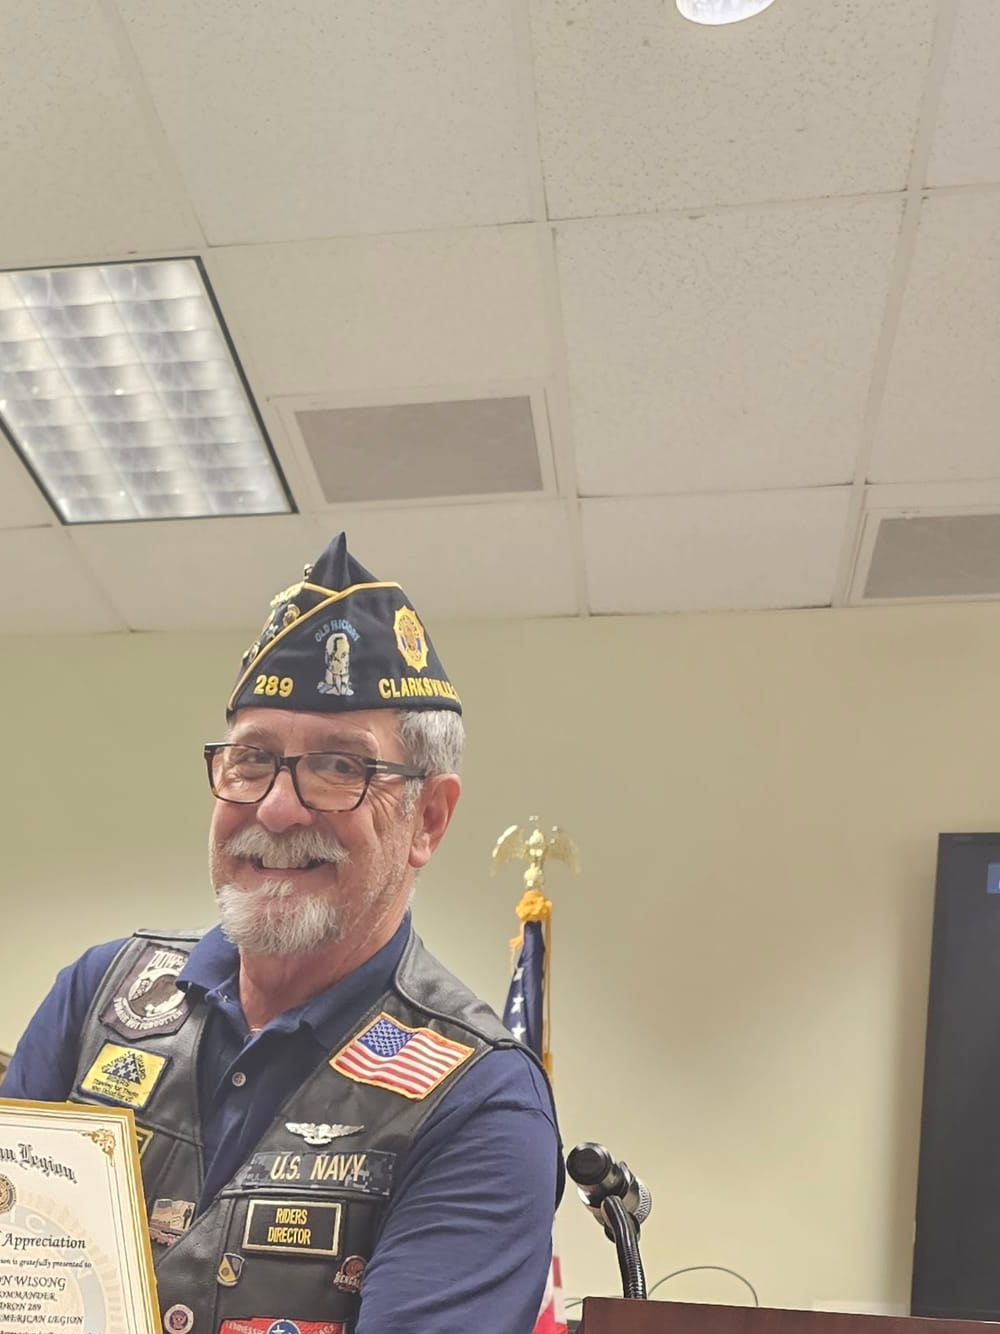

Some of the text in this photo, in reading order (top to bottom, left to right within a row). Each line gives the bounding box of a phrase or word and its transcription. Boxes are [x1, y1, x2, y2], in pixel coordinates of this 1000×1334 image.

[253, 675, 294, 697] 289
[18, 1143, 78, 1185] Legion
[269, 1154, 367, 1182] U.S. NAVY
[275, 1208, 308, 1225] RIDERS
[1, 1232, 86, 1250] Appreciation
[267, 1227, 311, 1245] DIRECTOR
[19, 1258, 52, 1270] gratefully
[52, 1260, 84, 1270] presented
[84, 1262, 93, 1270] to
[14, 1275, 68, 1291] WISONG
[26, 1303, 43, 1312] 289
[46, 1314, 84, 1327] LEGION
